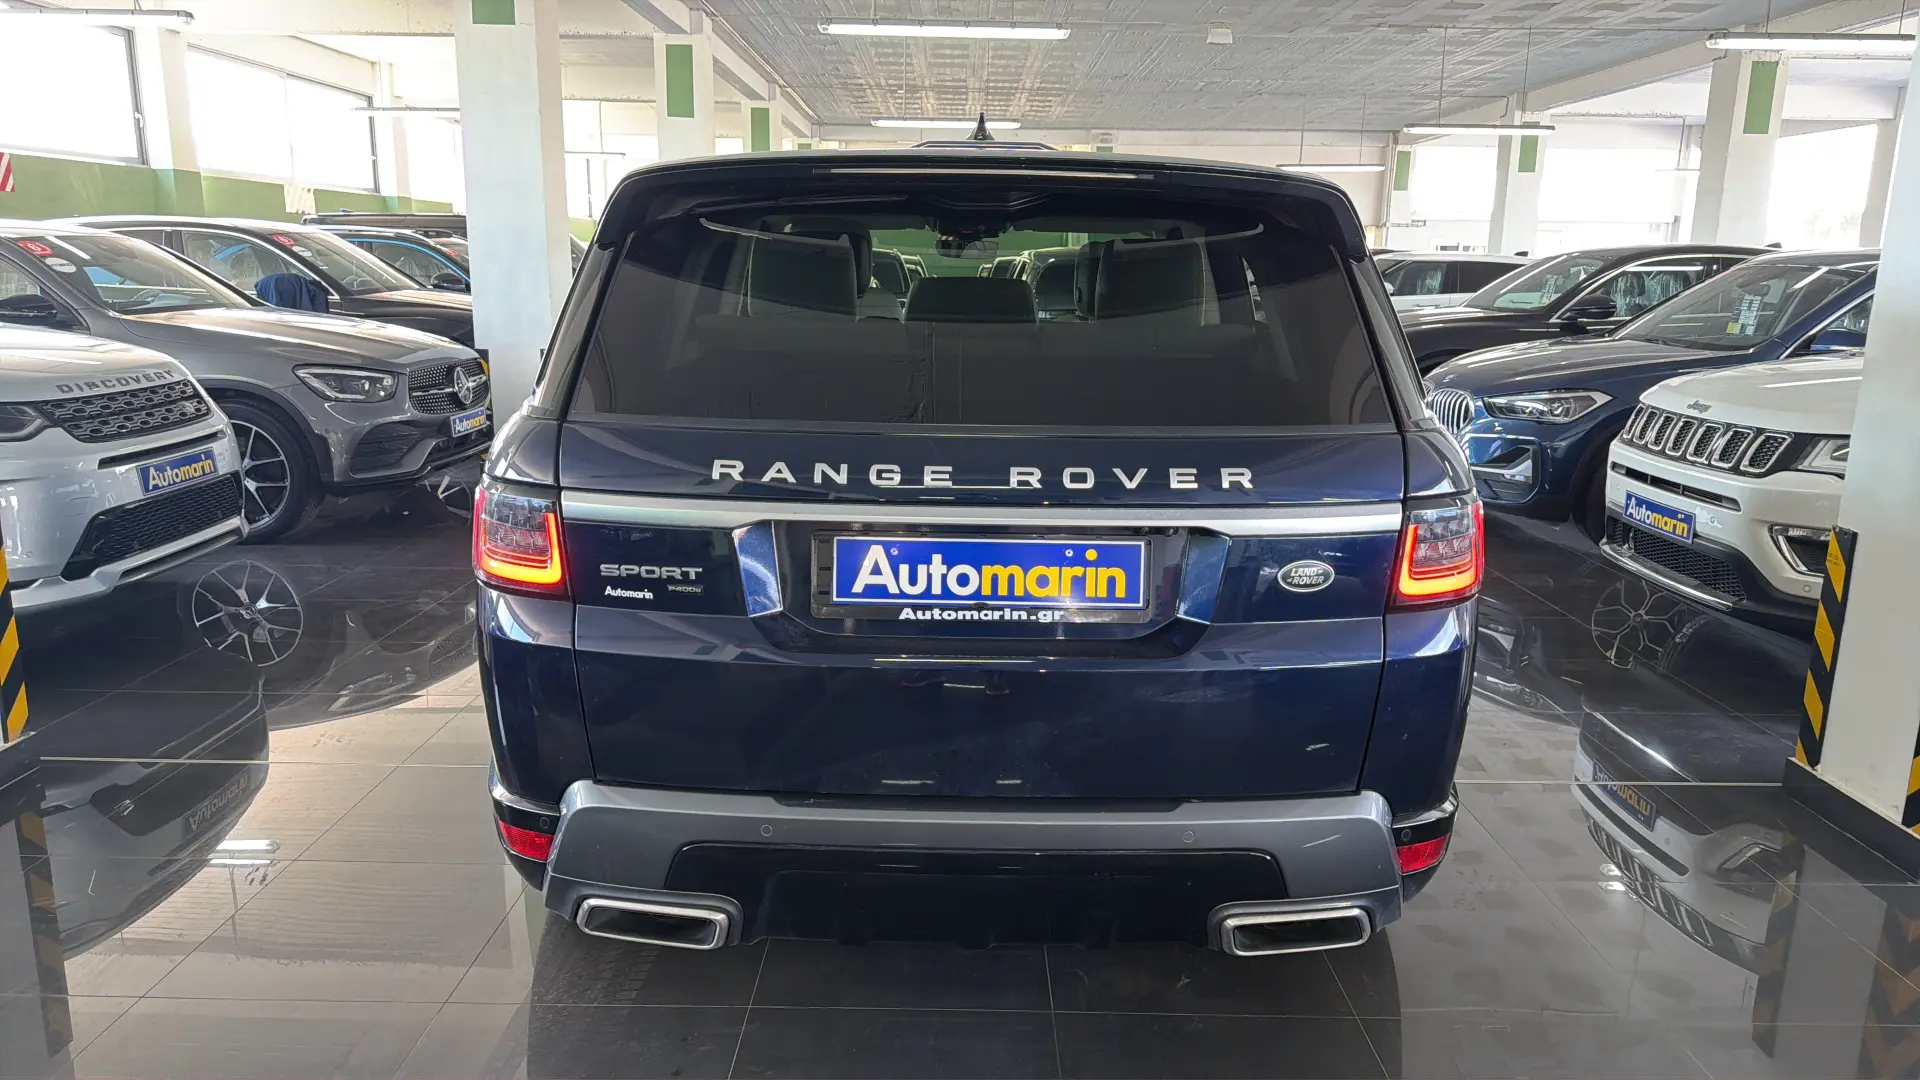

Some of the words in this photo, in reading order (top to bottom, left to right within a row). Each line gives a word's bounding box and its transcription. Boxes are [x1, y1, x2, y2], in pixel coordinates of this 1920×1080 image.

[56, 369, 175, 394] DISCOVERY
[149, 454, 215, 491] Automarin
[711, 459, 953, 487] RANGE
[1009, 466, 1255, 490] ROVER
[1626, 496, 1689, 537] Automarin
[600, 563, 703, 580] SPORT
[851, 544, 1126, 598] Automarin
[1290, 567, 1318, 577] LAND
[1291, 576, 1325, 585] ROVER
[604, 585, 654, 600] Automarin
[898, 607, 1065, 623] Automarin.gr
